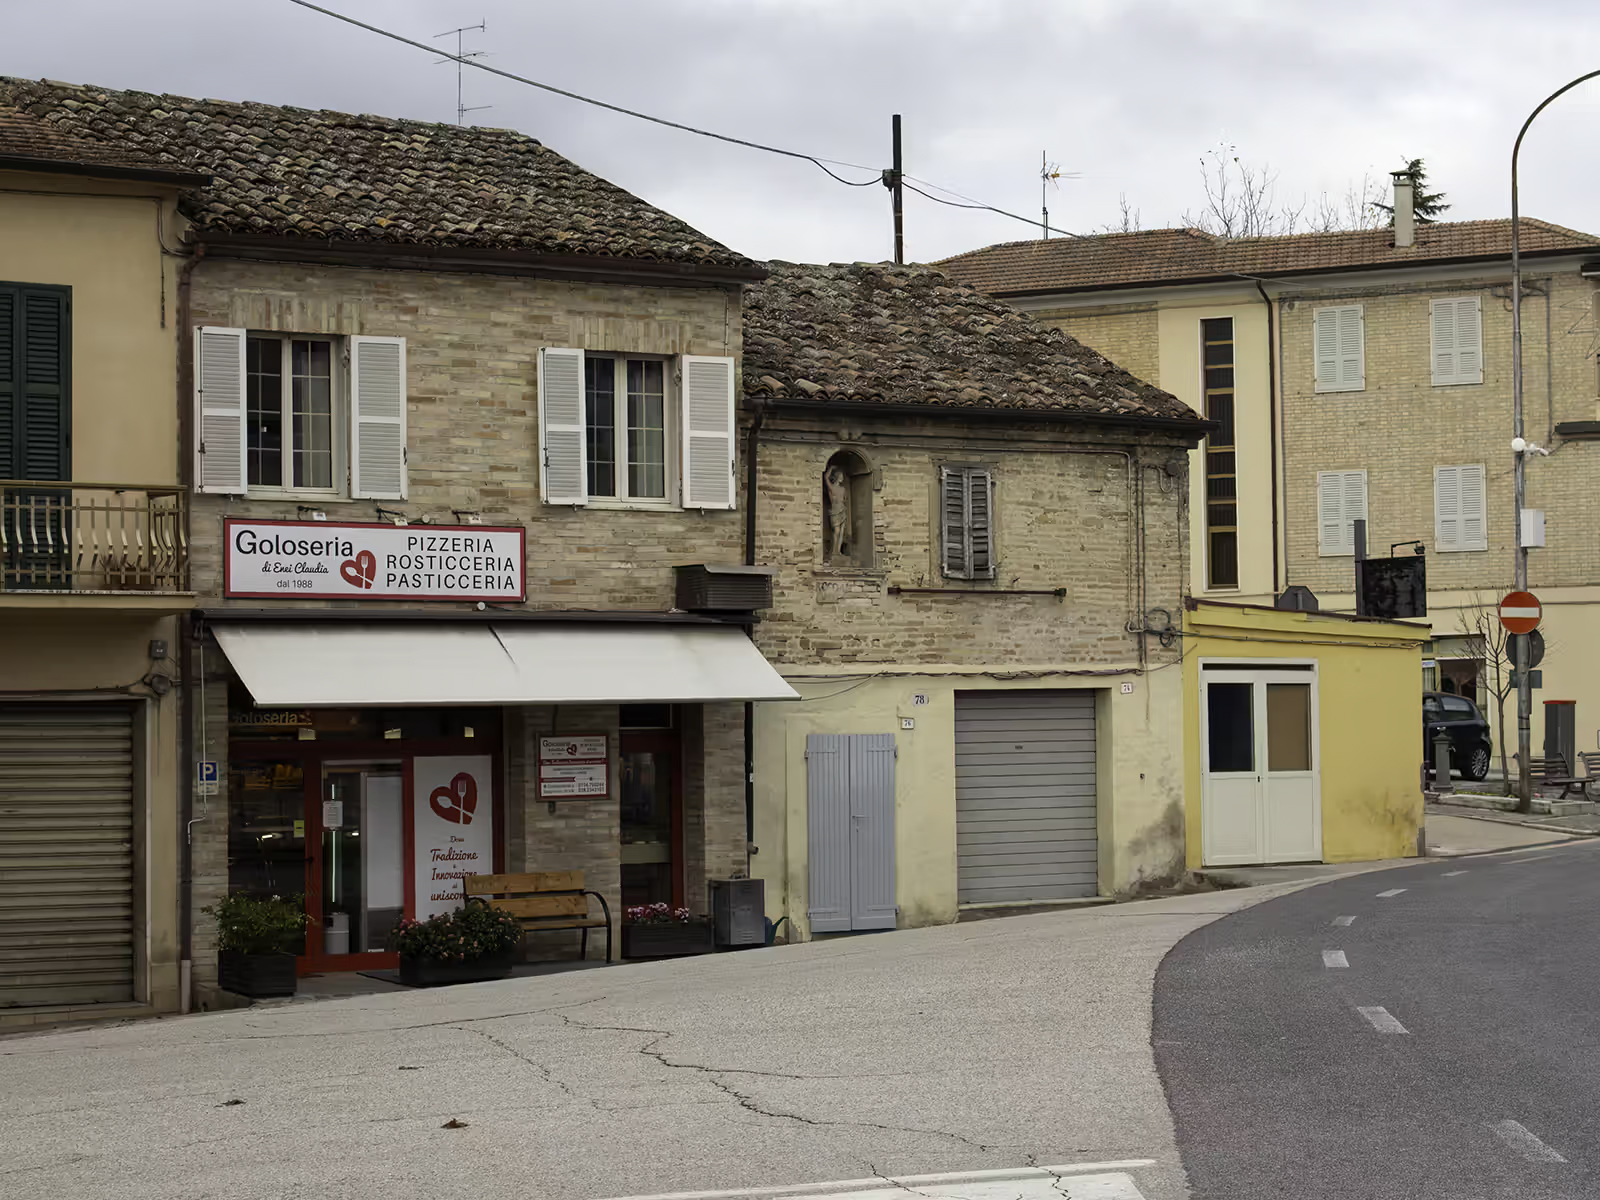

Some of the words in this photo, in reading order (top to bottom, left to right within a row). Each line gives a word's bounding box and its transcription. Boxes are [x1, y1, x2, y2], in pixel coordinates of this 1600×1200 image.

[235, 529, 354, 557] Goloseria
[407, 536, 494, 553] PIZZERIA
[261, 561, 271, 573] di
[273, 562, 293, 573] Enei
[294, 562, 329, 574] Claudia
[386, 554, 515, 572] ROSTICCERIA
[276, 580, 290, 588] dal
[292, 580, 313, 589] 1988
[386, 572, 515, 590] PASTICCERIA
[915, 694, 925, 704] 78
[233, 711, 298, 724] oloseria
[202, 763, 214, 779] P
[430, 846, 479, 862] Tradizione
[430, 889, 466, 901] uniscon
